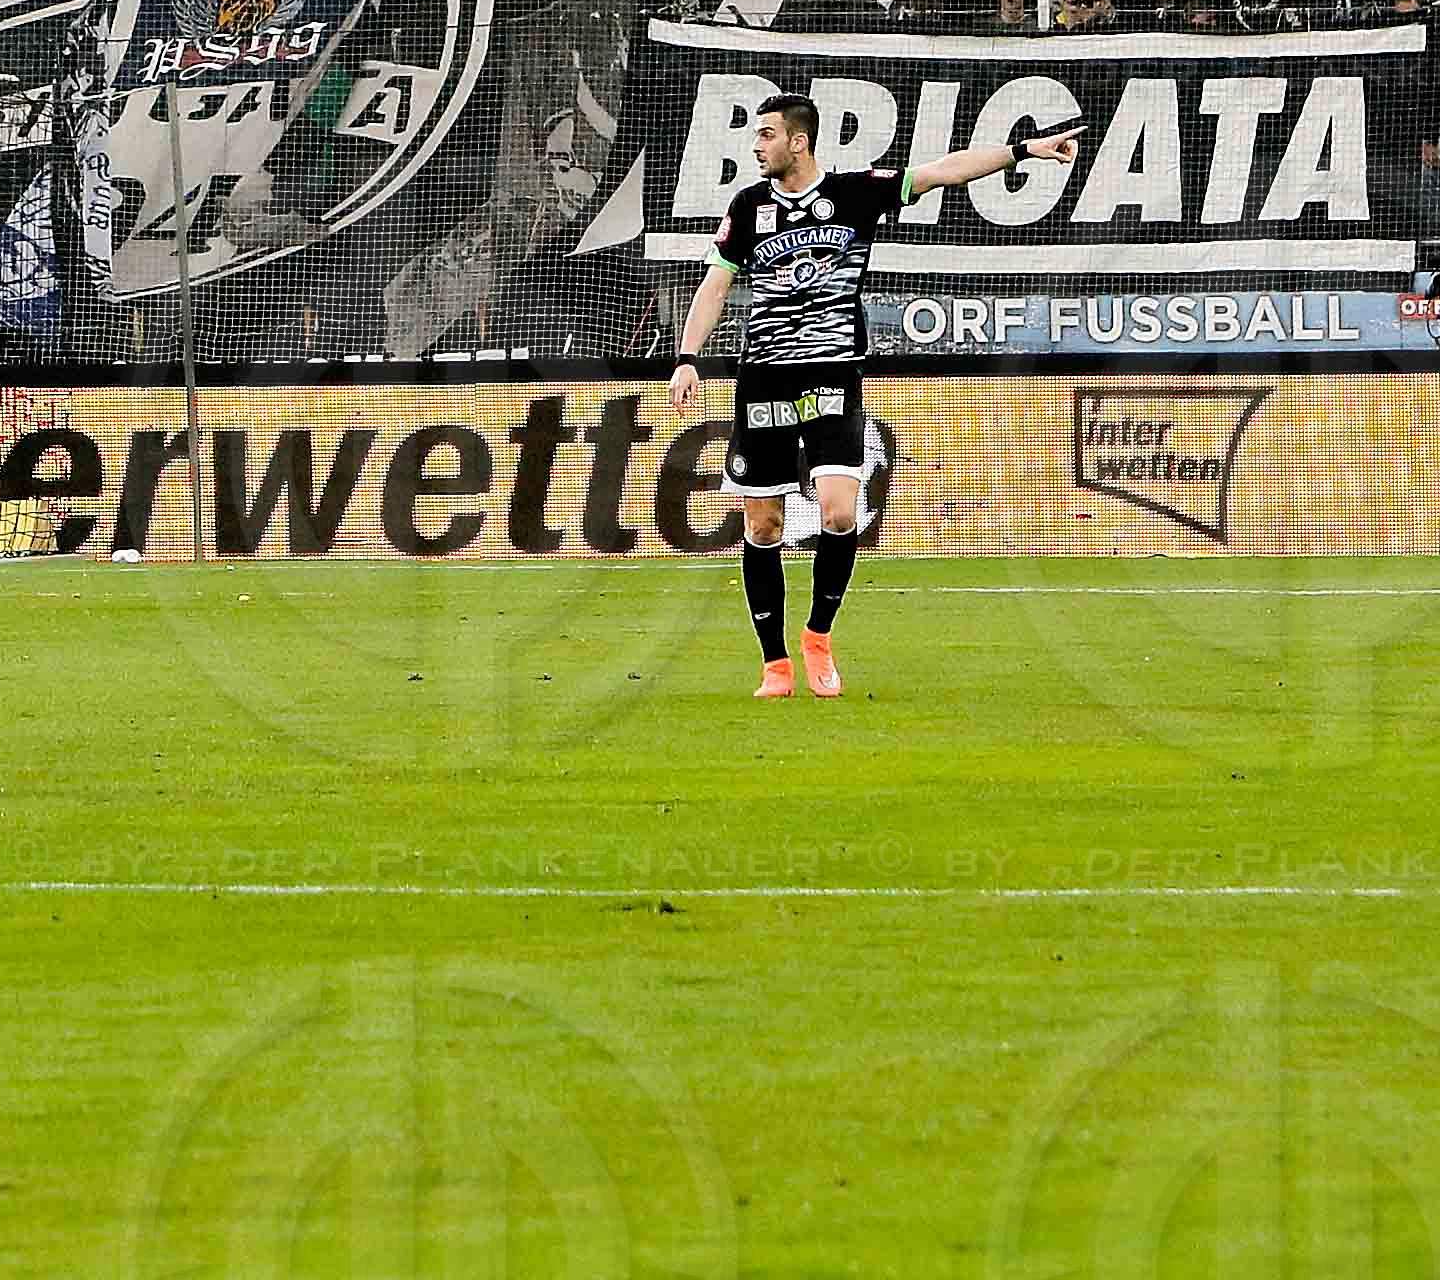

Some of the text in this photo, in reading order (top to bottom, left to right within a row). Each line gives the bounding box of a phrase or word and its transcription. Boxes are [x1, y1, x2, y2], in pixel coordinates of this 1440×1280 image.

[671, 74, 1372, 227] BRIGATA
[900, 292, 1362, 348] ORF FUSSBALL
[747, 395, 845, 429] GRAZ
[1083, 394, 1172, 448] inter
[1093, 449, 1222, 484] wetten
